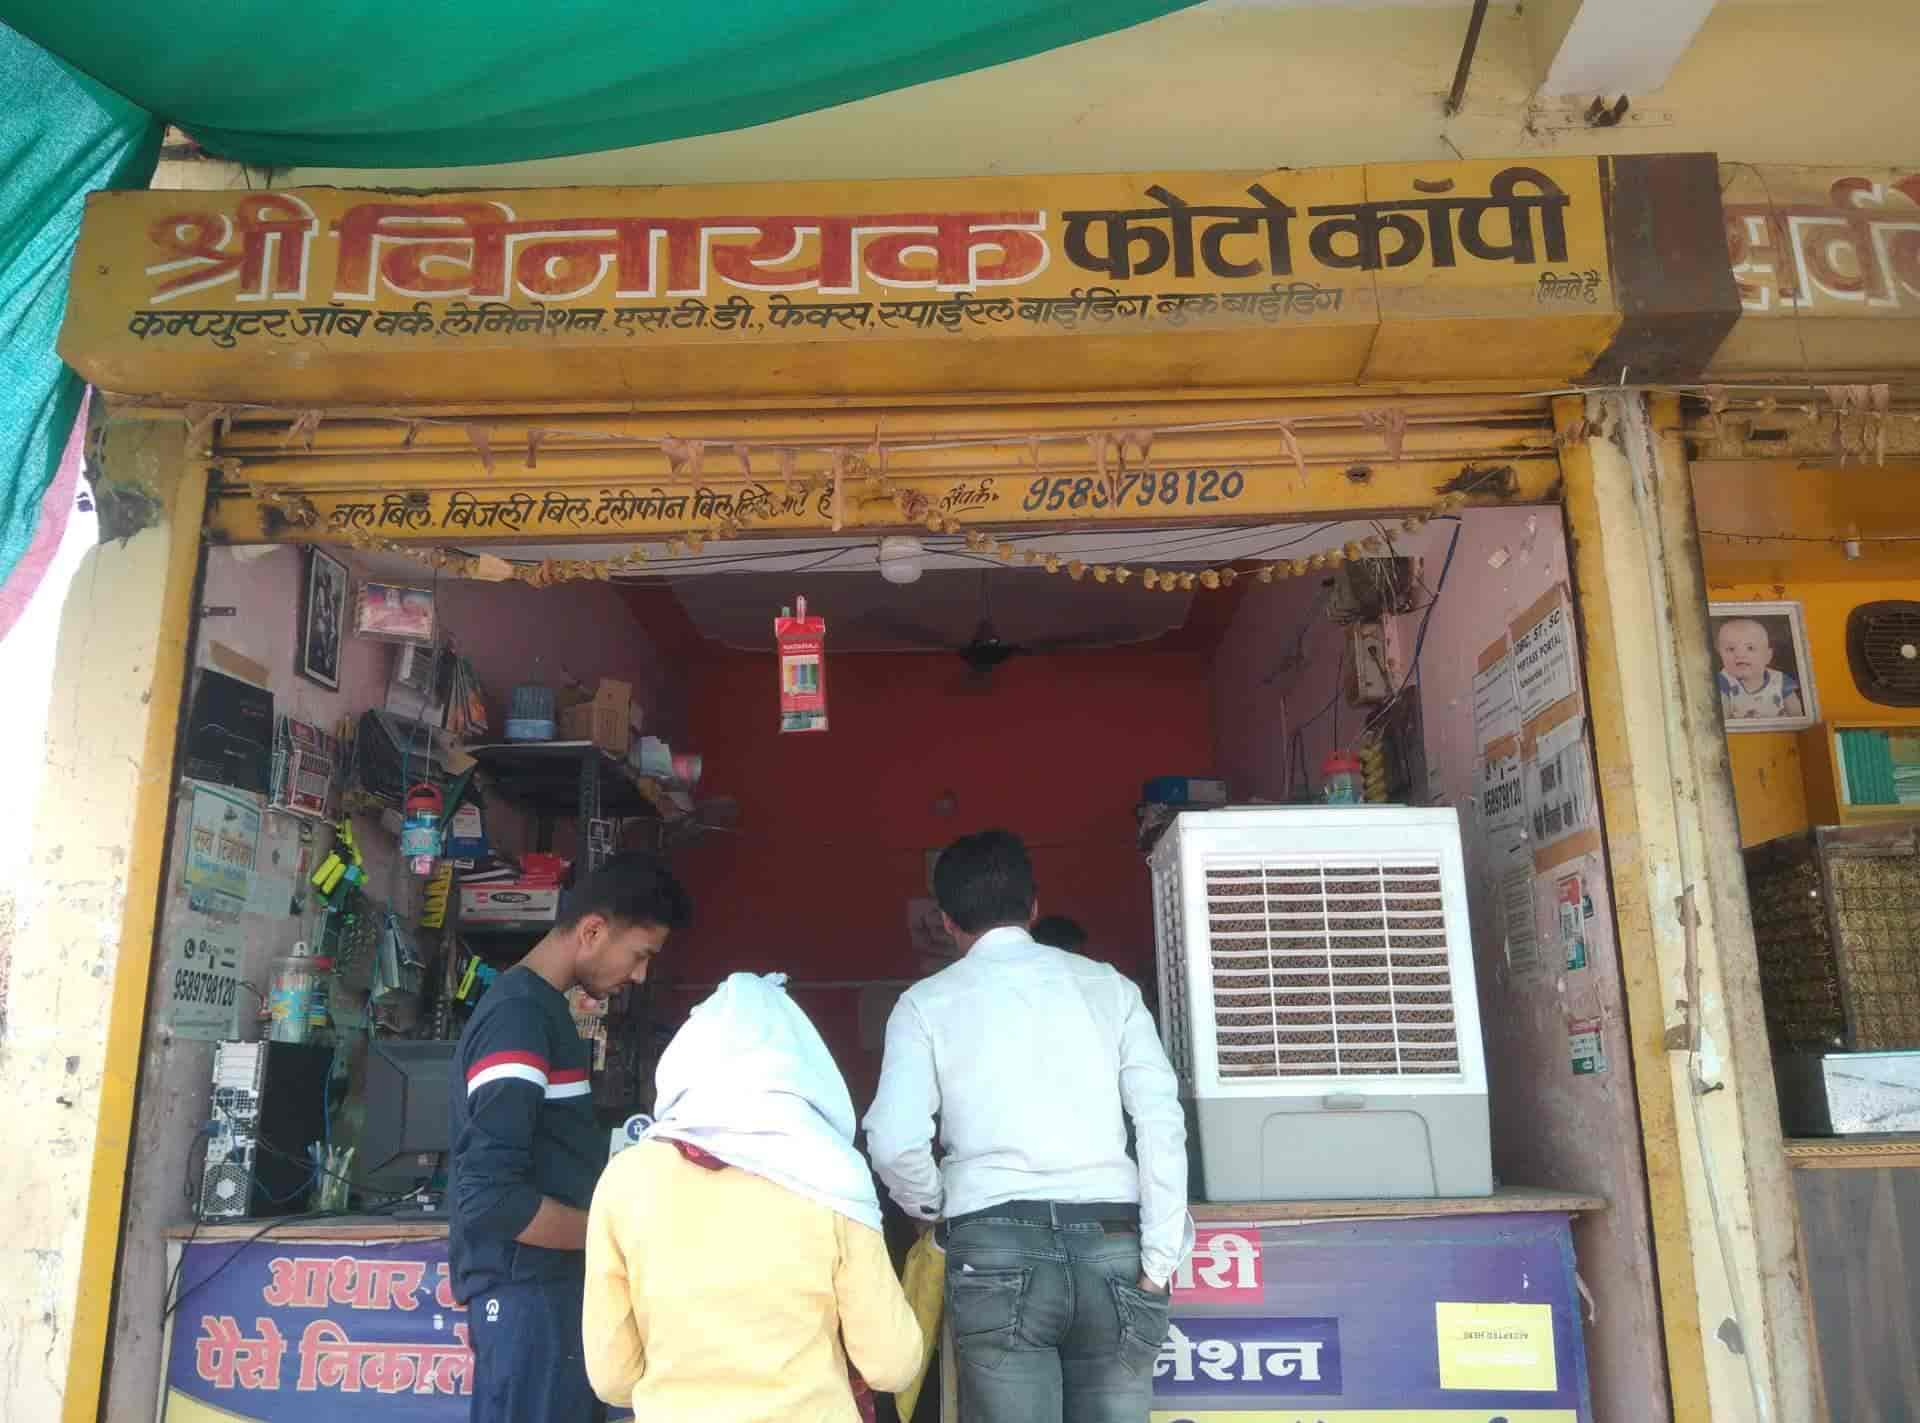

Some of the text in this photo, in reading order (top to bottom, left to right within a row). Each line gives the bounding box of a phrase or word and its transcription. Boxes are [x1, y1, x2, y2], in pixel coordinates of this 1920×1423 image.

[145, 166, 1571, 304] श्री विनायक फोटो कॉपी
[290, 301, 372, 337] जॉब
[441, 491, 537, 532] बिजली
[263, 1256, 425, 1311] आधार
[196, 1316, 287, 1389] पैसे
[1153, 1323, 1323, 1382] नेशन
